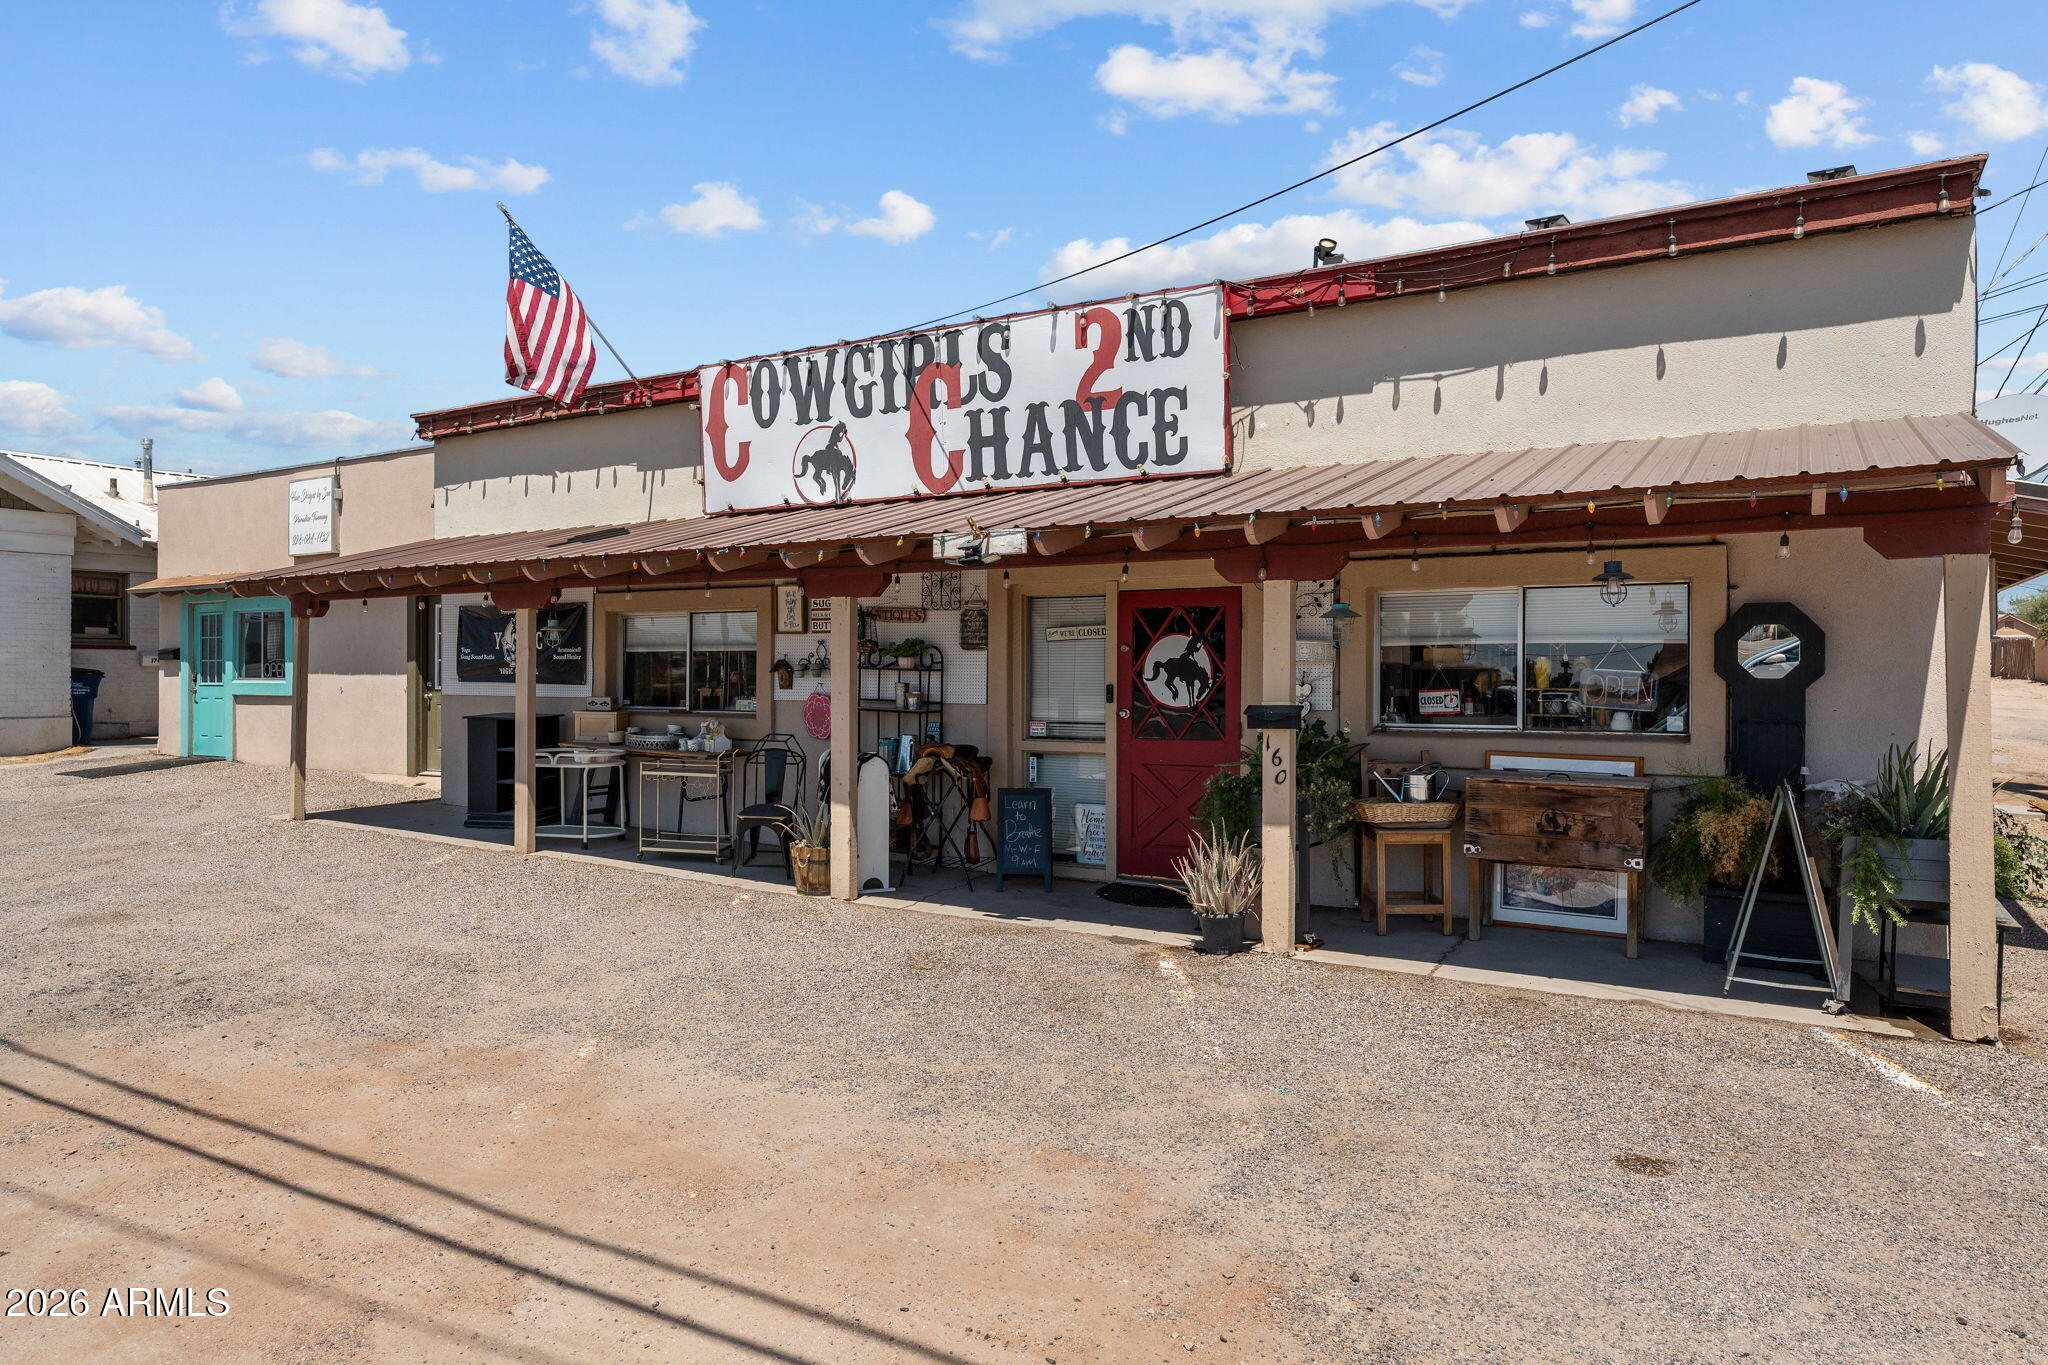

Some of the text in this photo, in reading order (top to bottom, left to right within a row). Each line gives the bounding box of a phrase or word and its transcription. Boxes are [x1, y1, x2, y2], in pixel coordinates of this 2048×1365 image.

[1074, 299, 1192, 412] 2ND
[1981, 413, 2038, 426] HughesNet
[905, 362, 1188, 494] CHANCE
[1078, 627, 1106, 636] CLOSED
[1586, 675, 1654, 706] OPEN
[1420, 695, 1444, 705] CLOSED
[1005, 795, 1037, 810] Learn
[1015, 811, 1026, 820] to
[1081, 809, 1105, 824] Home
